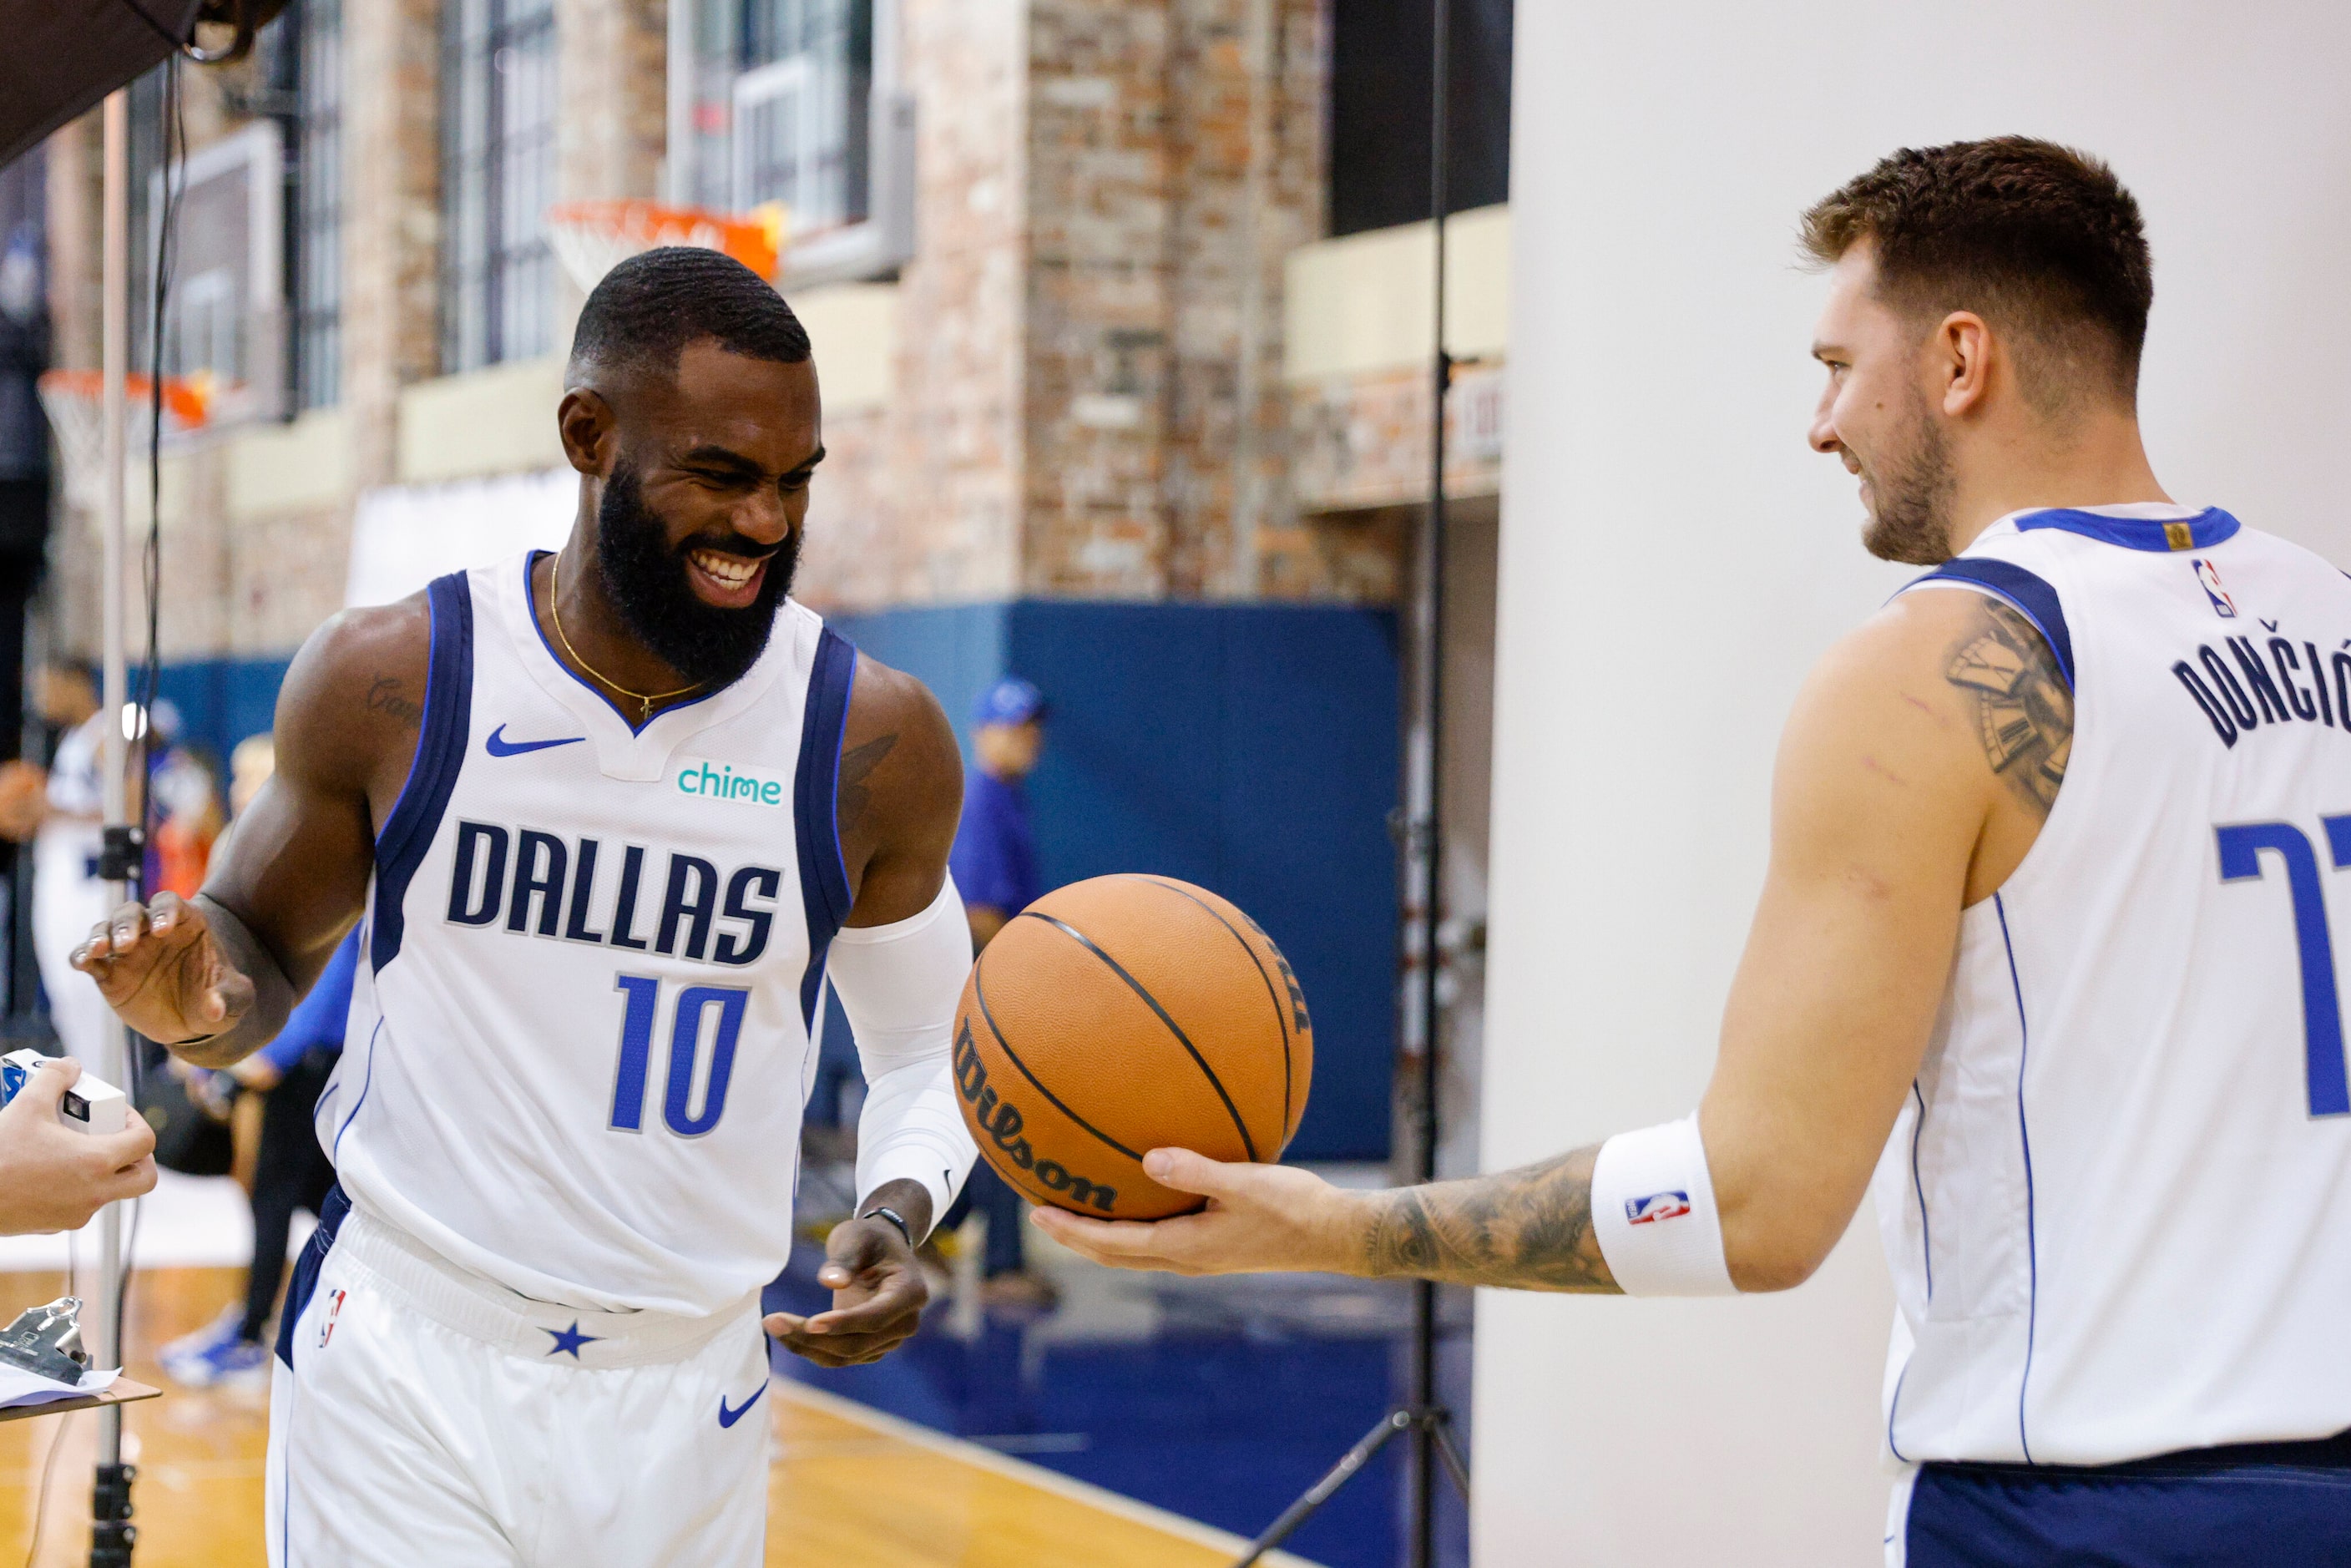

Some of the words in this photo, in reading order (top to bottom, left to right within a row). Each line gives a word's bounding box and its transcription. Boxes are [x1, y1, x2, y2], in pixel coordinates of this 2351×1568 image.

[678, 761, 781, 805] chime
[444, 816, 785, 969] DALLAS
[2212, 813, 2351, 1120] 7
[607, 970, 751, 1140] 10
[953, 1015, 1118, 1211] Wilson
